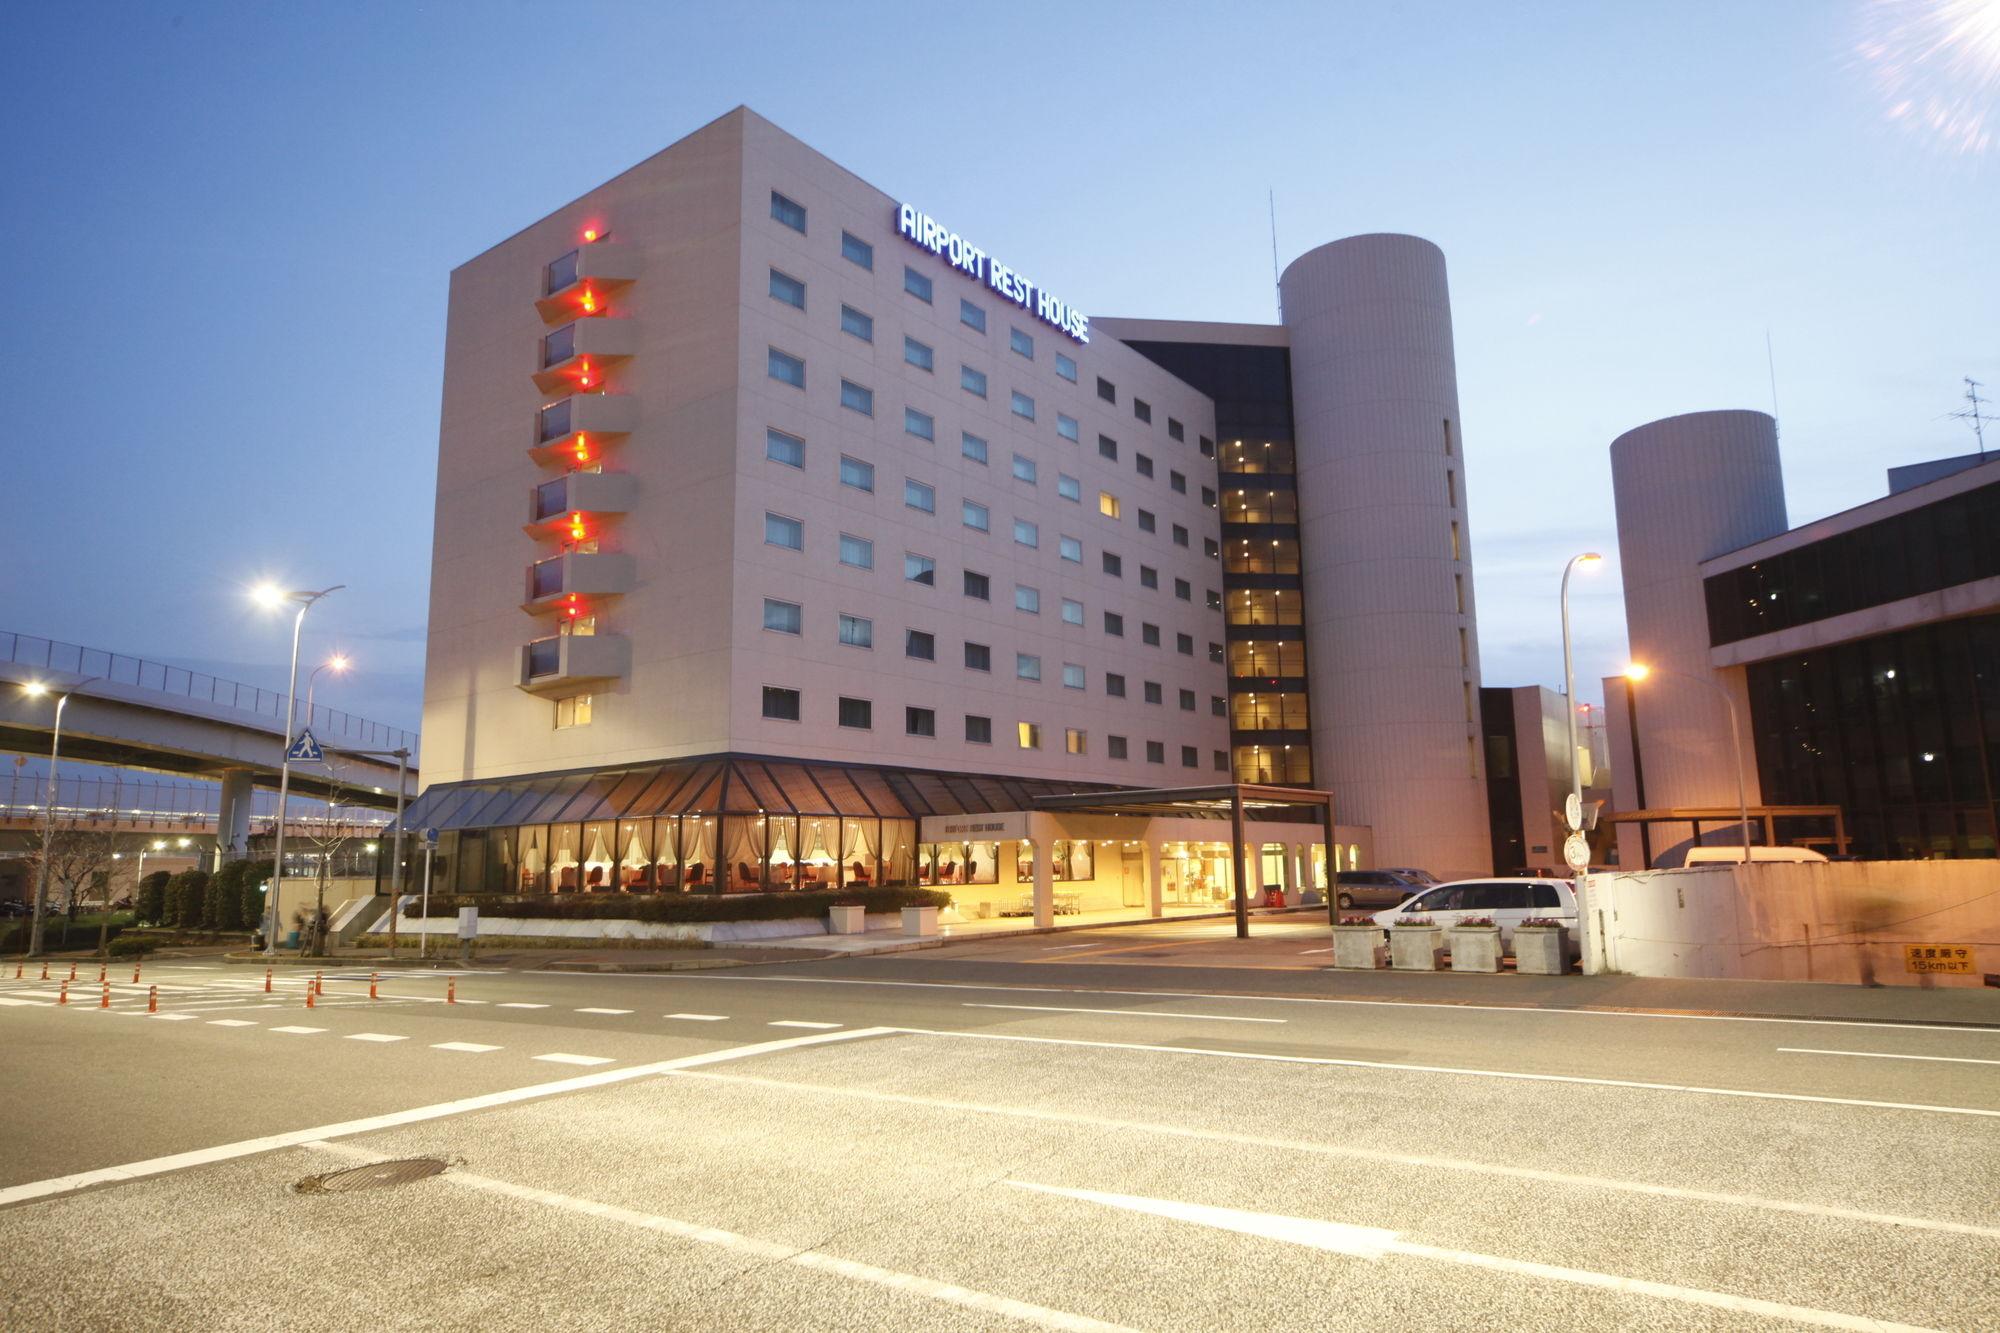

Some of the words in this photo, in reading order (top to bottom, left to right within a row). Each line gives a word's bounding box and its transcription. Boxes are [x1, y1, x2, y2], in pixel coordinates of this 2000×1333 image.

[900, 203, 986, 279] AIRPORT
[990, 256, 1034, 308] REST
[1038, 287, 1090, 344] HOUSE
